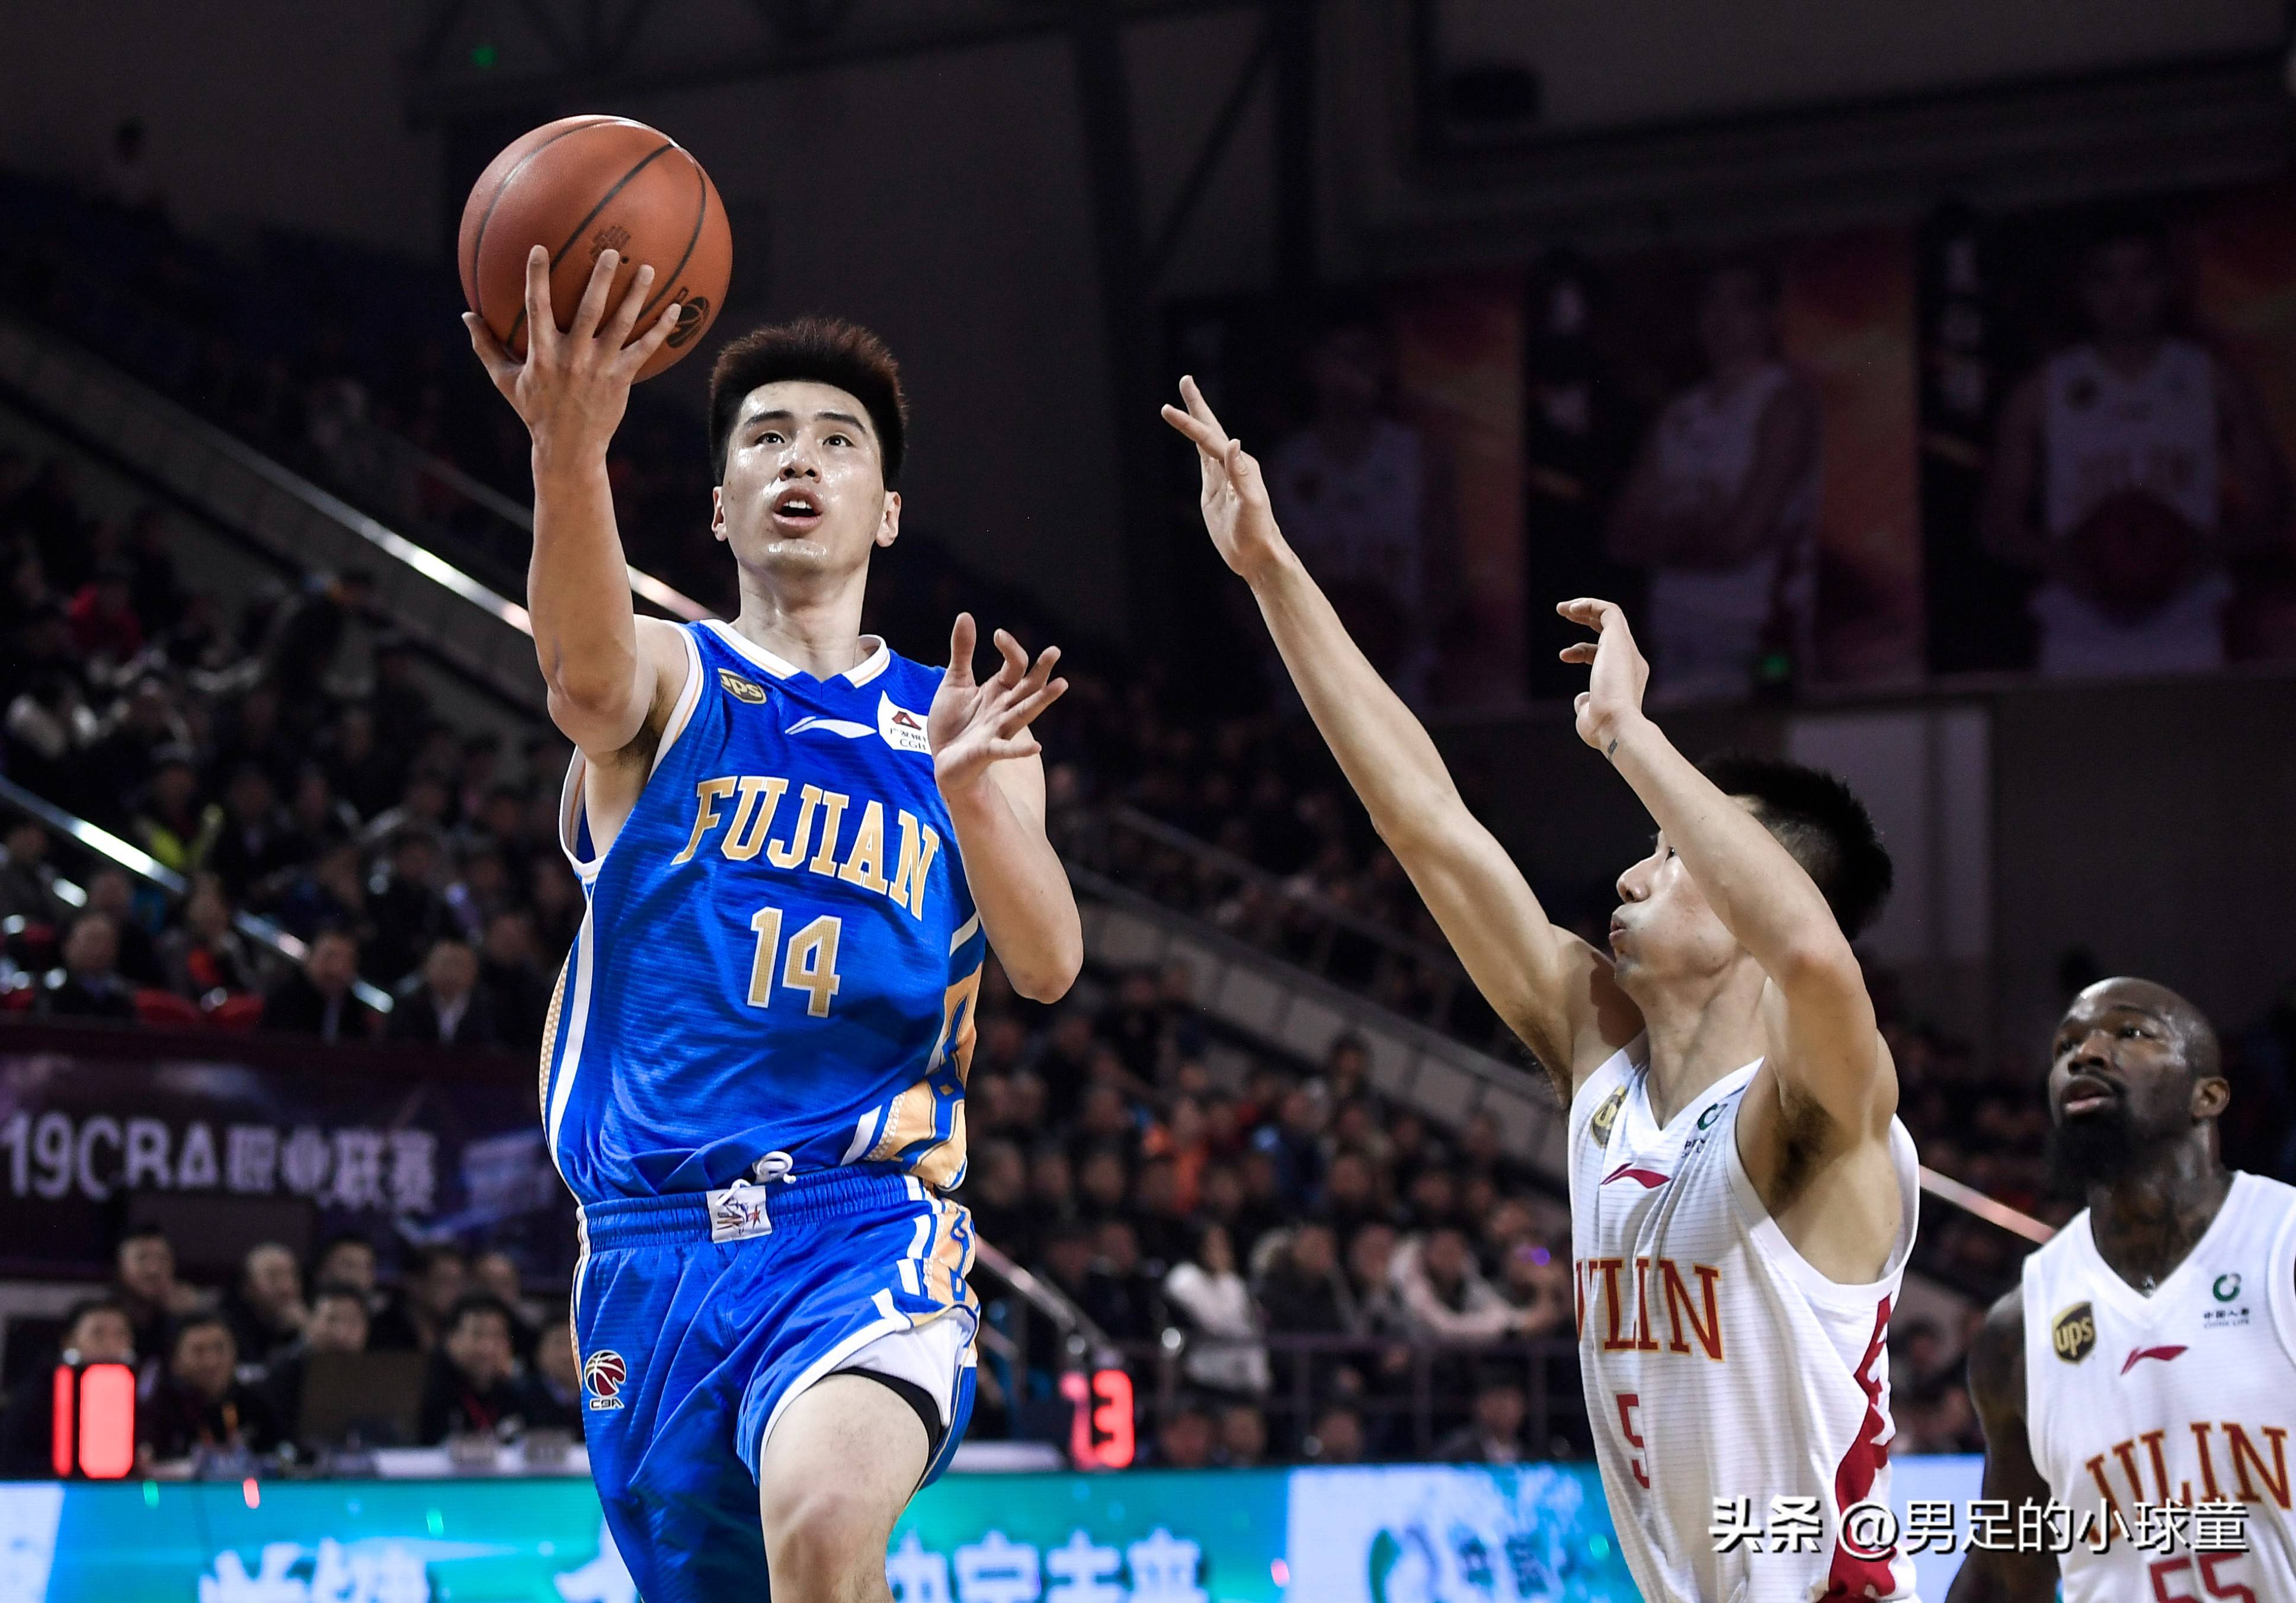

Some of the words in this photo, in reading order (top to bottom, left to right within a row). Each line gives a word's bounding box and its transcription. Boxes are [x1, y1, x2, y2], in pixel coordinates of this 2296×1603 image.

[671, 775, 940, 922] FUJIAN
[747, 906, 843, 1019] 14
[1576, 1257, 1725, 1362] LIN
[2056, 1316, 2093, 1357] ups
[590, 1397, 625, 1411] CBA
[2084, 1420, 2292, 1546] JILIN
